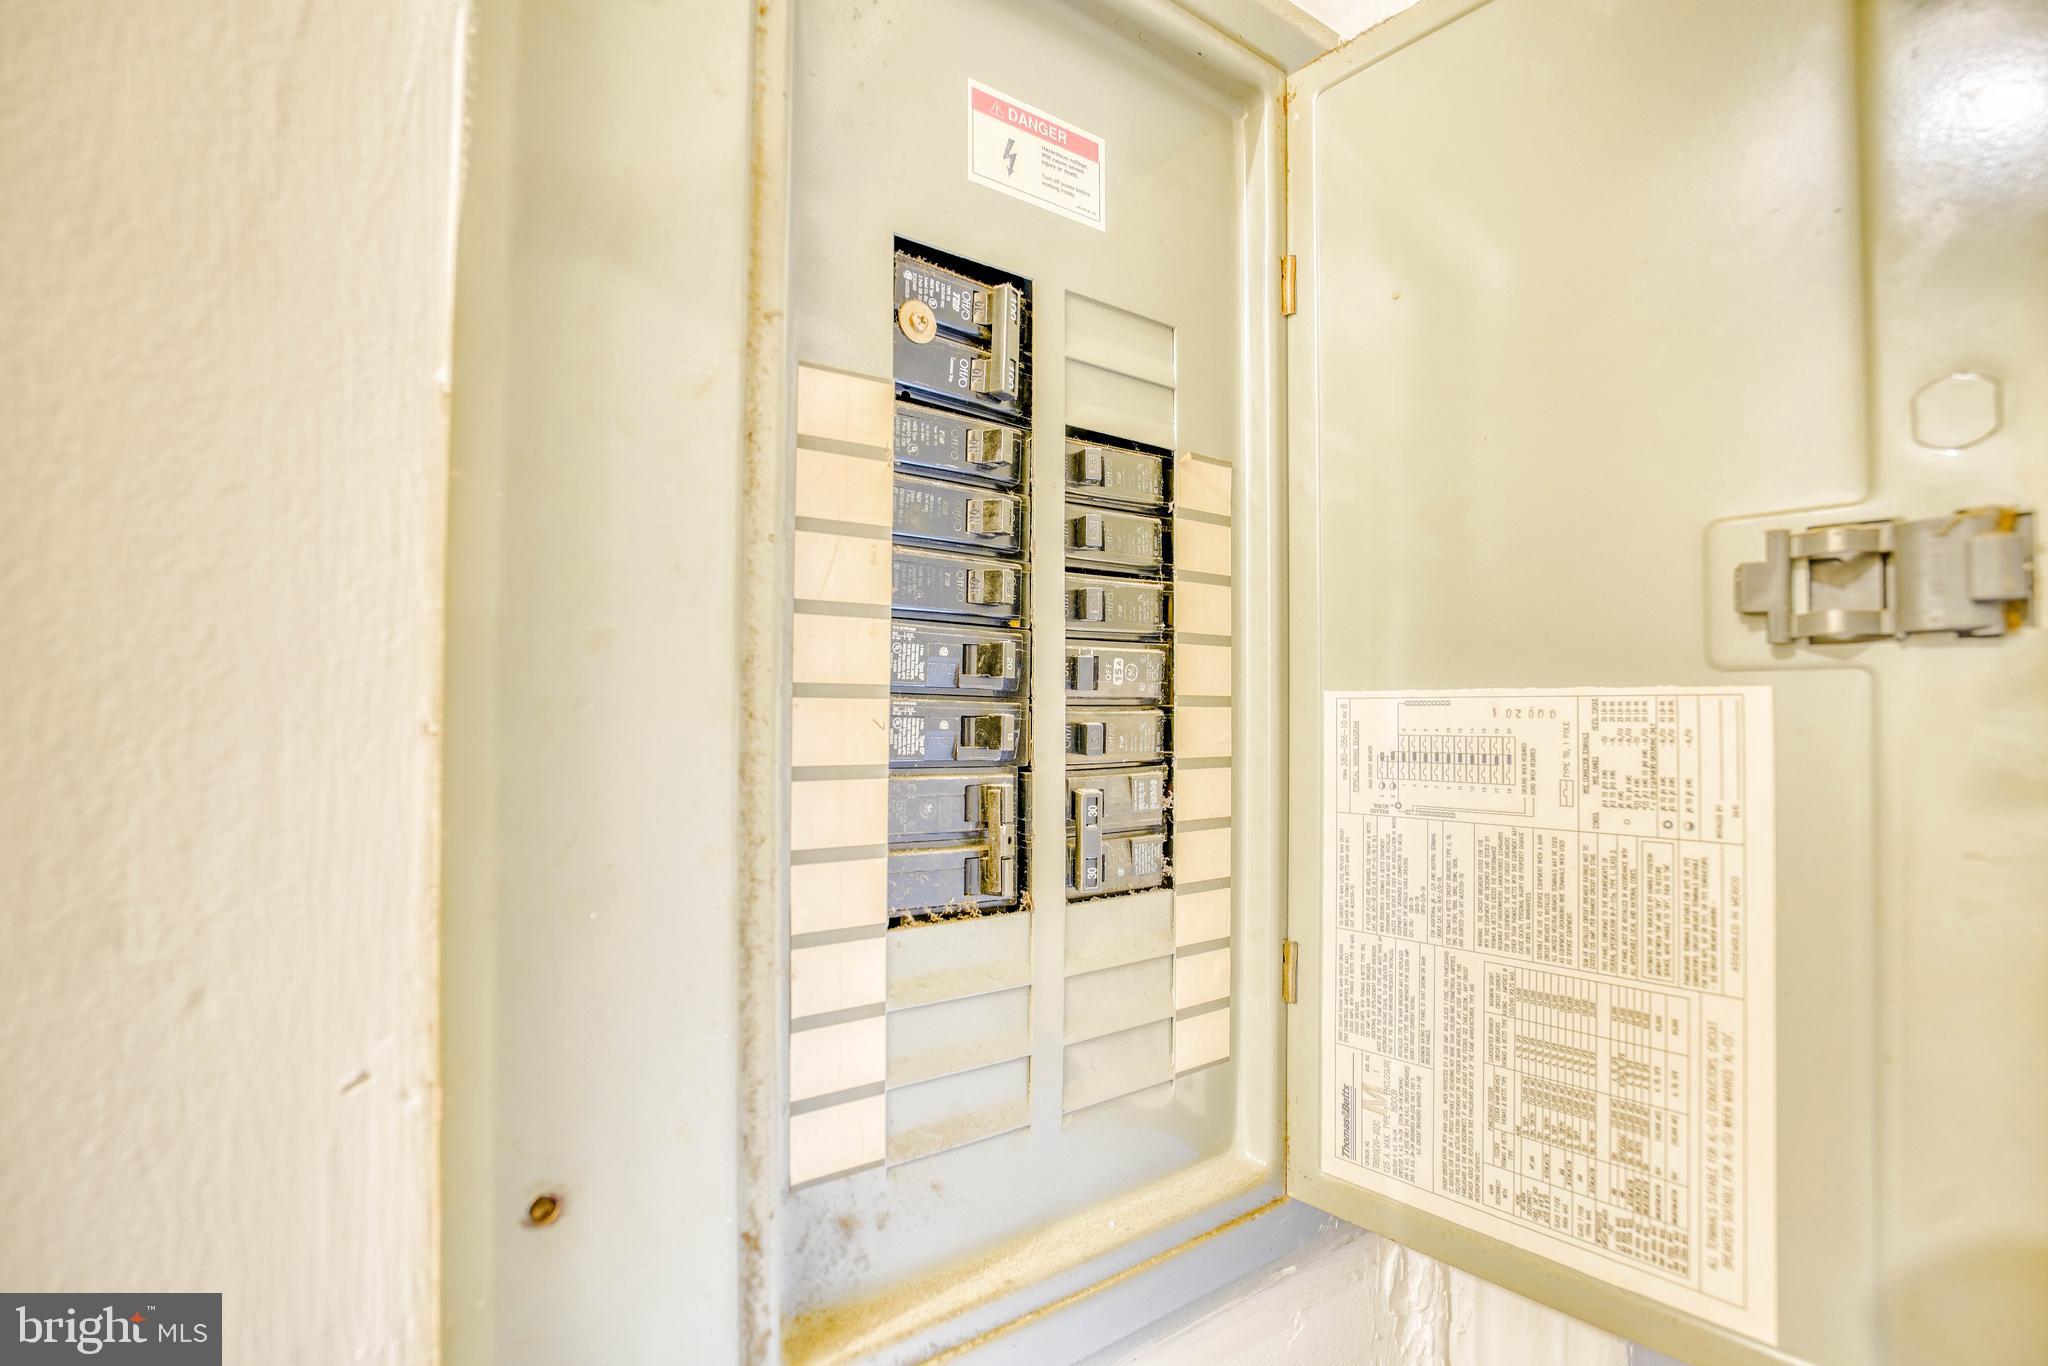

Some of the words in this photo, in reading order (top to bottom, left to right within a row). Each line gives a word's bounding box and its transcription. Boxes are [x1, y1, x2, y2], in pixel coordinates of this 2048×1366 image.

[1008, 107, 1068, 145] DANGER
[1006, 657, 1014, 670] 20
[1115, 660, 1123, 682] 15A
[1340, 720, 1348, 768] 380-086-10
[1088, 805, 1098, 817] 30
[1087, 867, 1097, 880] 30
[1383, 1058, 1391, 1096] ENCLOSURE
[1390, 1088, 1398, 1114] INDOOR
[1341, 1084, 1351, 1158] Thomas&Betts
